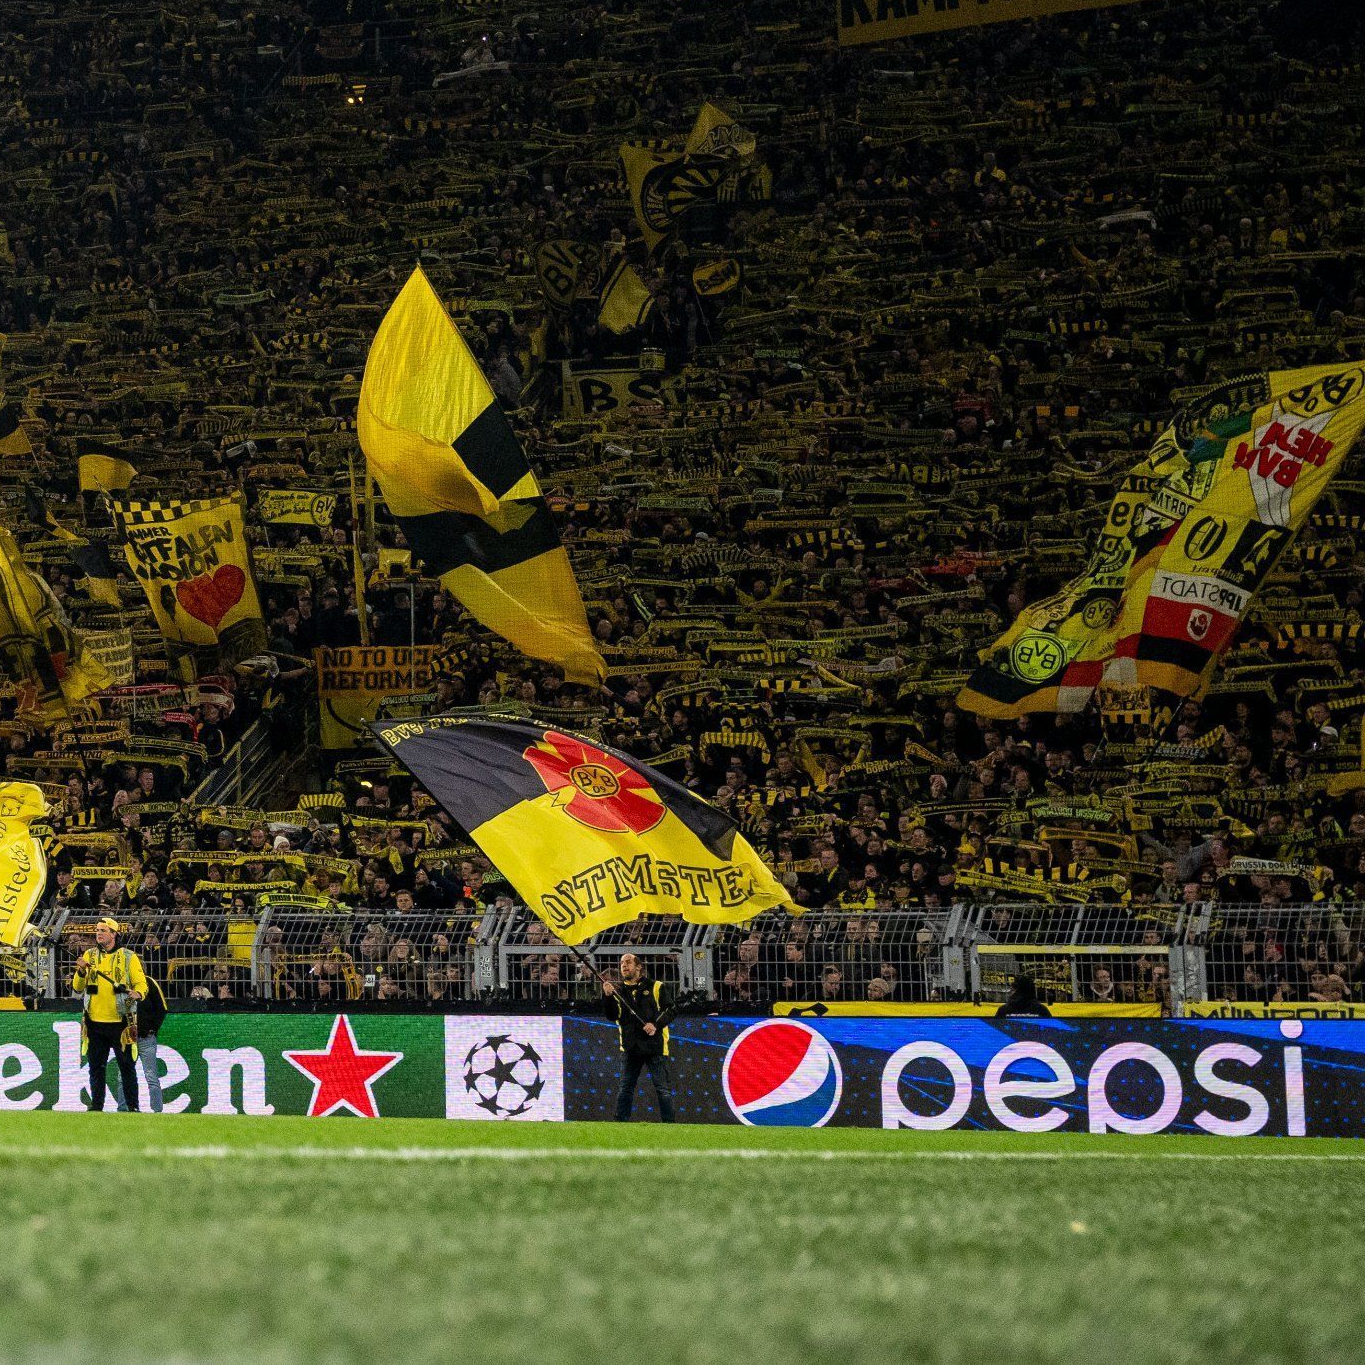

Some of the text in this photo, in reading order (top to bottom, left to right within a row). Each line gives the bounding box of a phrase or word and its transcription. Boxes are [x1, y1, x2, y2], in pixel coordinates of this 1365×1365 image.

[323, 649, 352, 667] NO
[361, 649, 386, 667] TO
[322, 671, 431, 690] REFORMS
[577, 765, 614, 789] BVB
[593, 785, 607, 794] 09
[304, 857, 350, 870] USSIA FOREVER
[1231, 860, 1267, 869] ORUSSIA
[73, 868, 132, 877] USSIA DORTM
[881, 1019, 1307, 1137] pepsi
